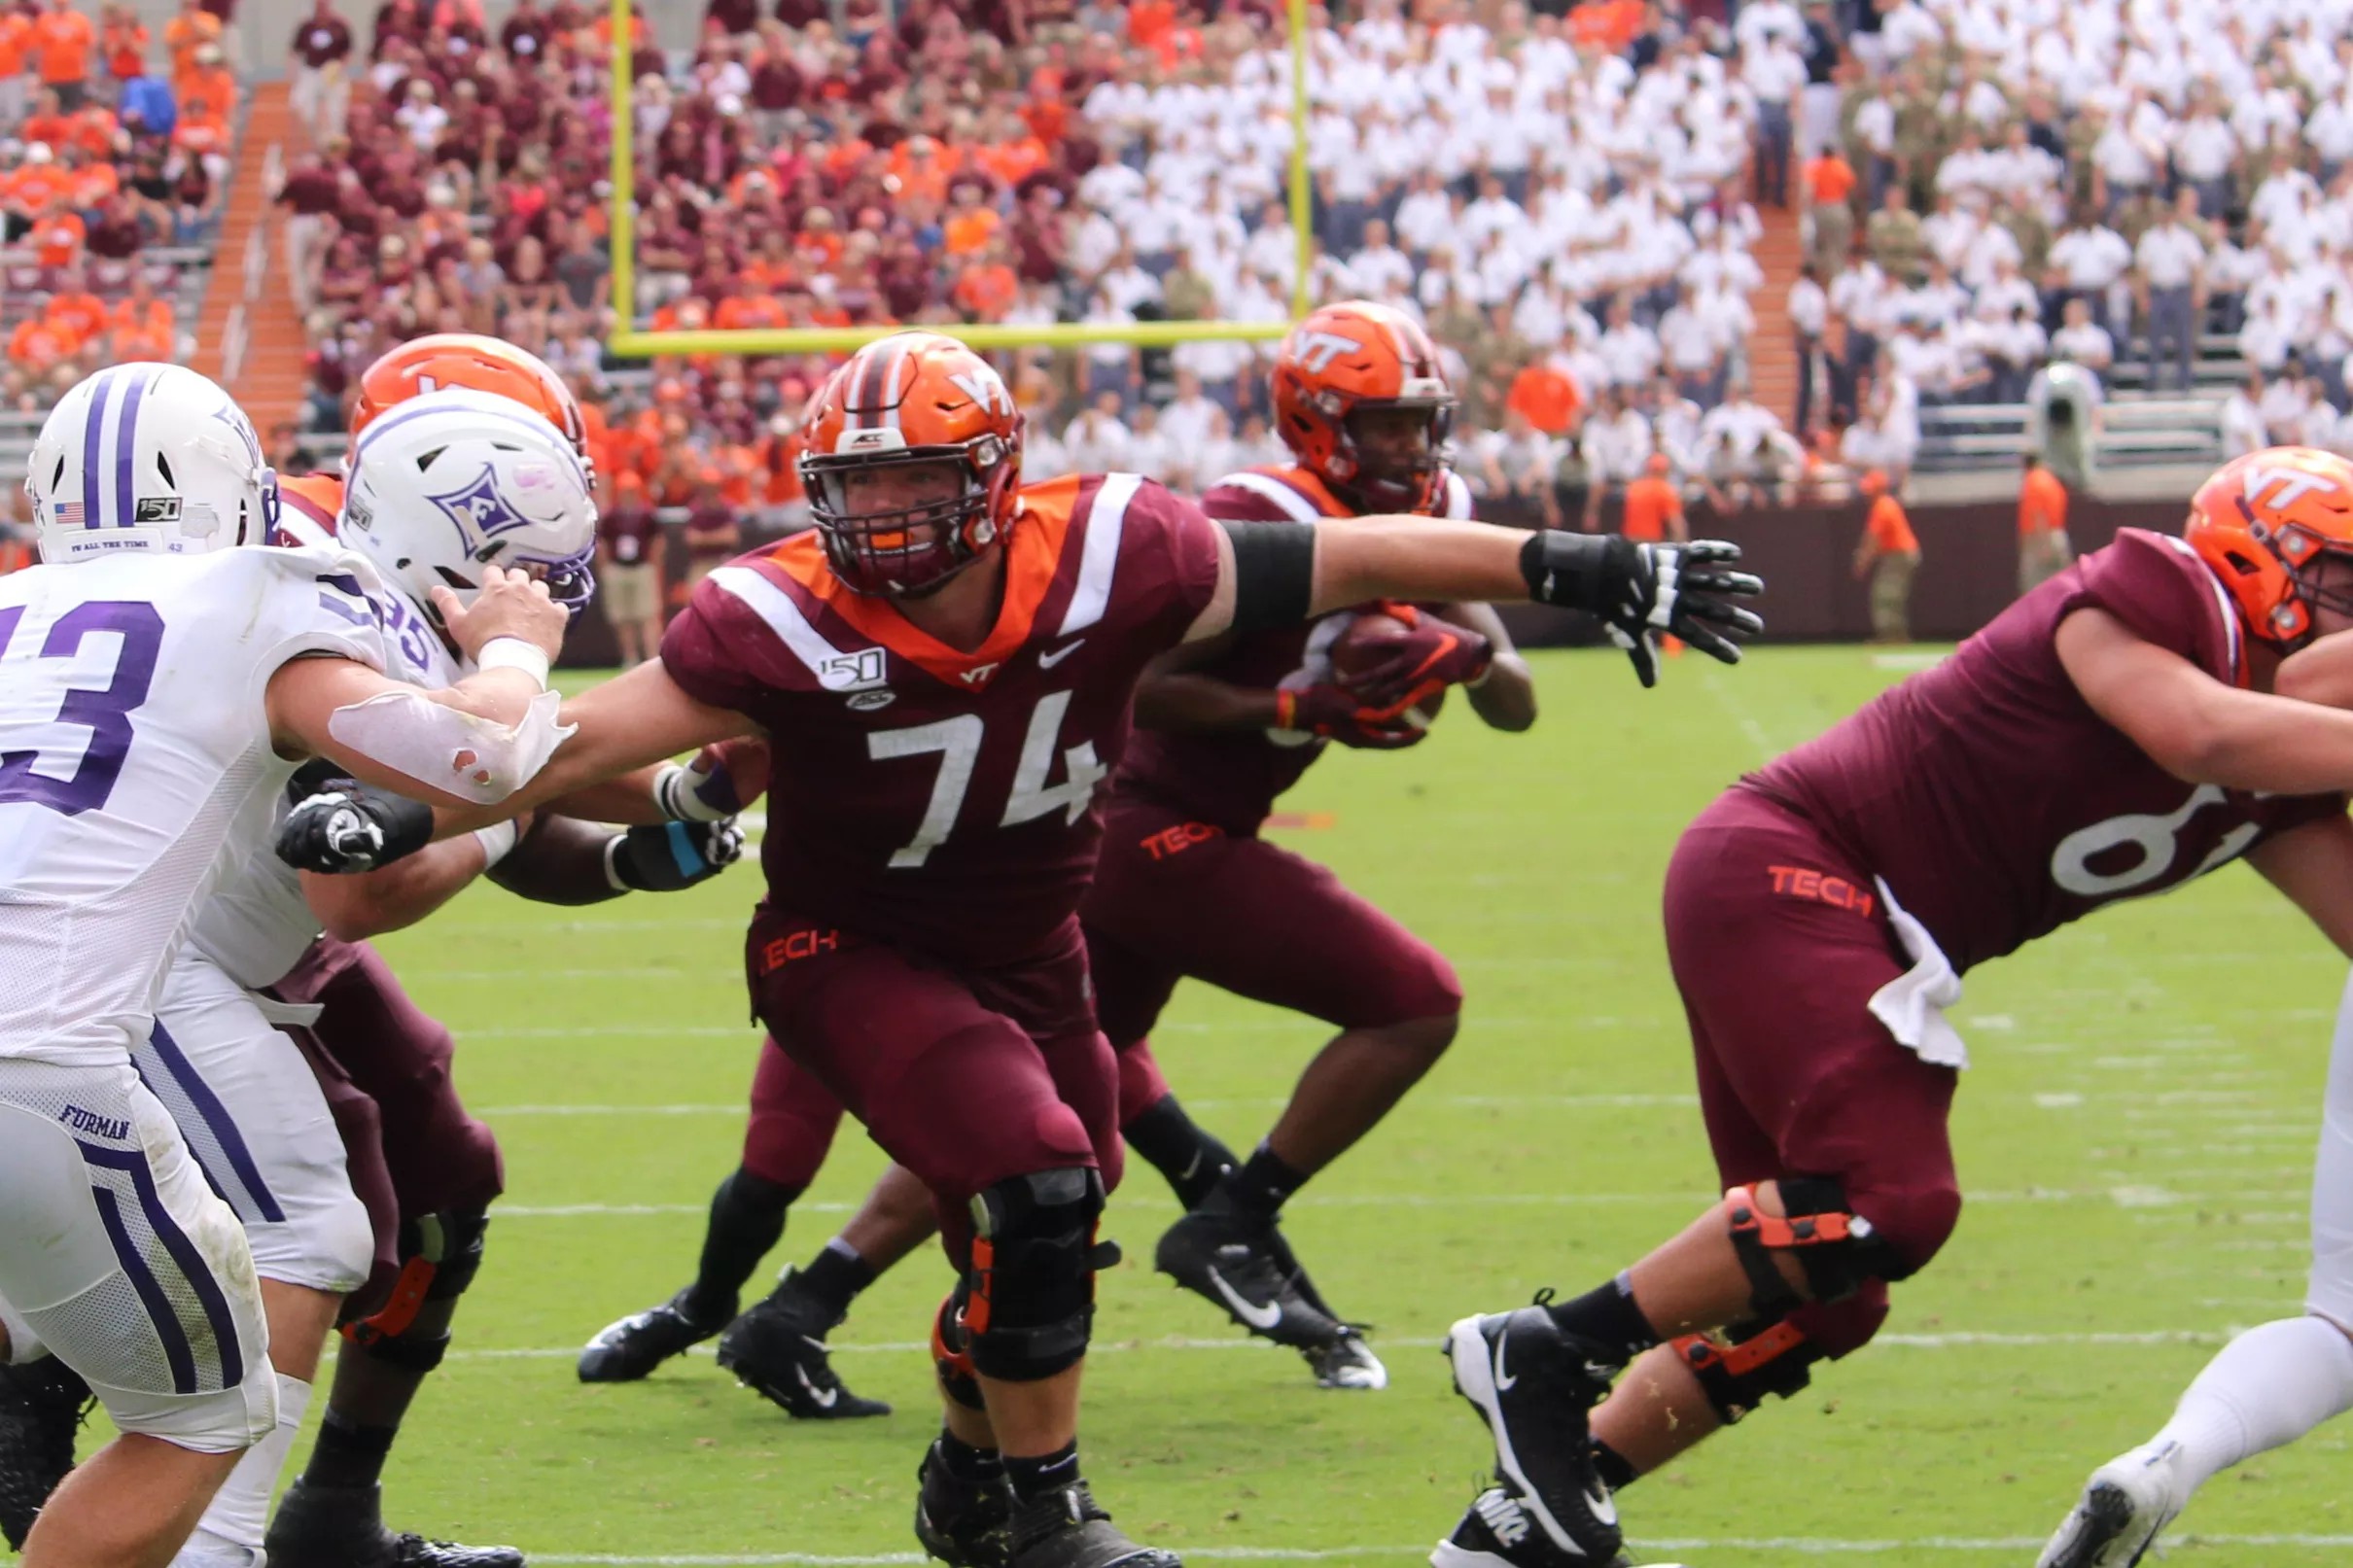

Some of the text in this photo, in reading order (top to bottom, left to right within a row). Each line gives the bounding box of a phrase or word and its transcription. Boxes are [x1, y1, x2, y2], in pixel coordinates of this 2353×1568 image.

[1295, 331, 1363, 374] VT
[2242, 466, 2338, 510] VT
[137, 497, 182, 523] 150
[84, 541, 101, 551] ALL
[103, 540, 122, 549] THE
[123, 540, 149, 549] TIME
[820, 648, 885, 688] 150
[959, 662, 1000, 684] VT
[866, 688, 1108, 868] 74
[1767, 864, 1875, 919] TECH
[57, 1103, 130, 1140] FURMAN
